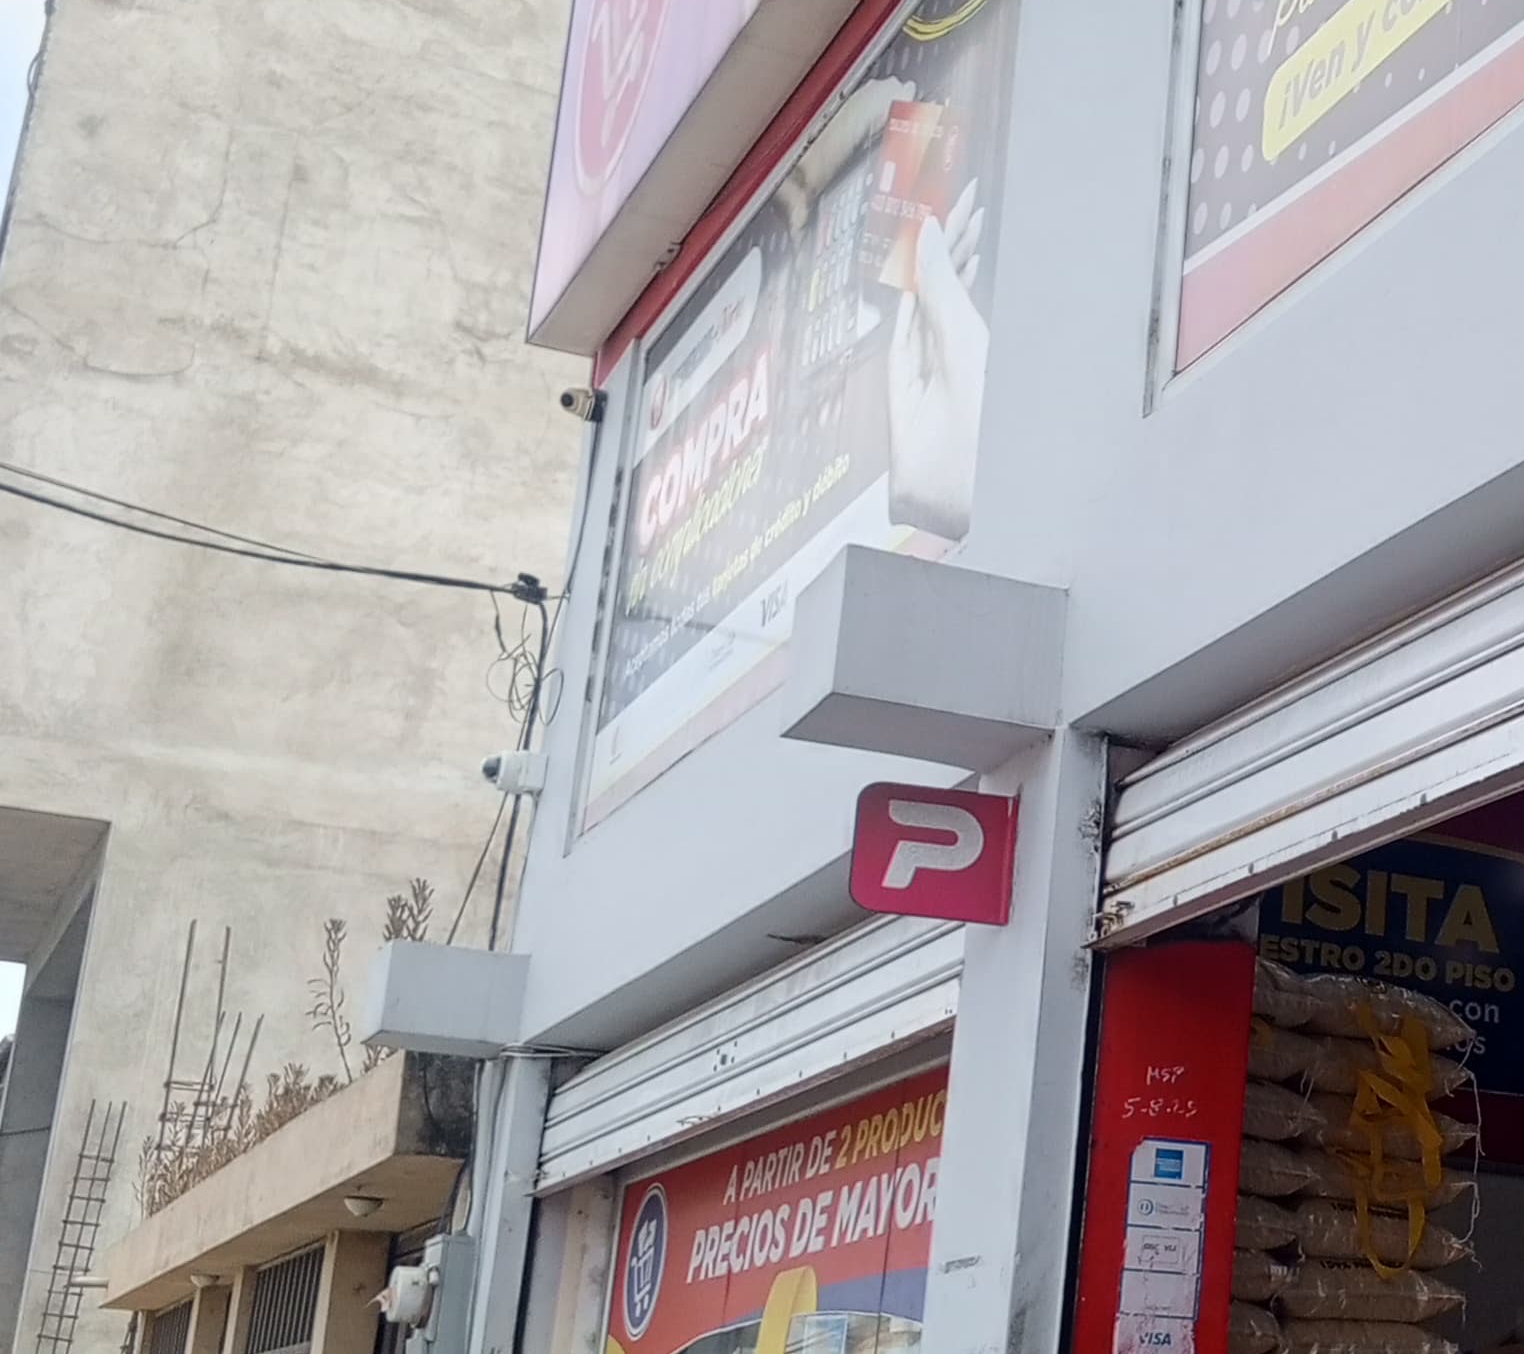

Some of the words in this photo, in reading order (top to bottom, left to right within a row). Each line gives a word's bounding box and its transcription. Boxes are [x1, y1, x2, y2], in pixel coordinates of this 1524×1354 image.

[1278, 39, 1345, 131] ¡Ven
[1349, 11, 1374, 70] y
[638, 351, 769, 546] COMPRA
[1373, 950, 1438, 983] 2DO
[1444, 960, 1517, 993] PISO
[1449, 999, 1501, 1025] con
[722, 1164, 738, 1206] A
[739, 1143, 804, 1202] PARTIR
[804, 1130, 837, 1180] DE
[835, 1124, 851, 1170] 2
[686, 1203, 791, 1285] PRECIOS
[789, 1190, 834, 1259] DE
[1138, 1332, 1172, 1346] VISA
